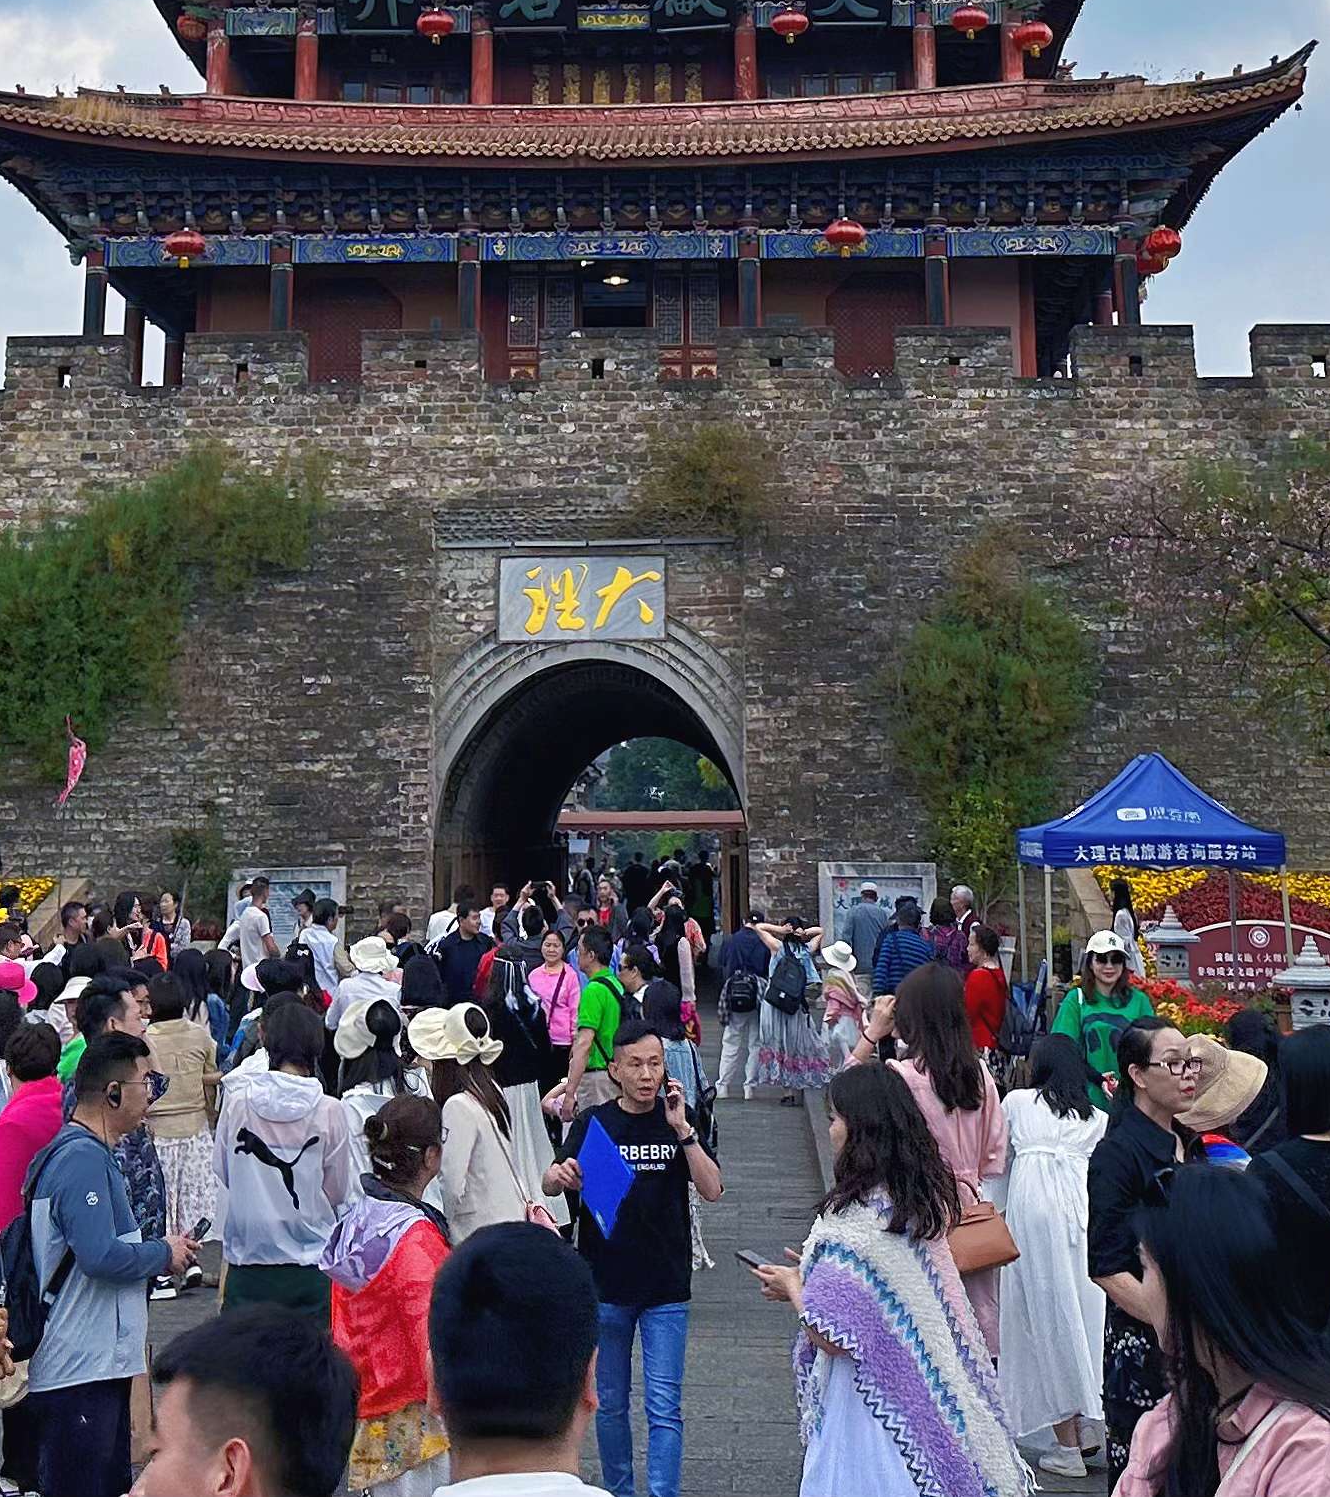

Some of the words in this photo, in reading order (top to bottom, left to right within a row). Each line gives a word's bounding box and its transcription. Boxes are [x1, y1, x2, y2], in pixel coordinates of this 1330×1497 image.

[522, 563, 663, 636] 大理
[1074, 844, 1258, 862] 大理古城旅游咨询服务站
[615, 1144, 677, 1160] RBEBRY
